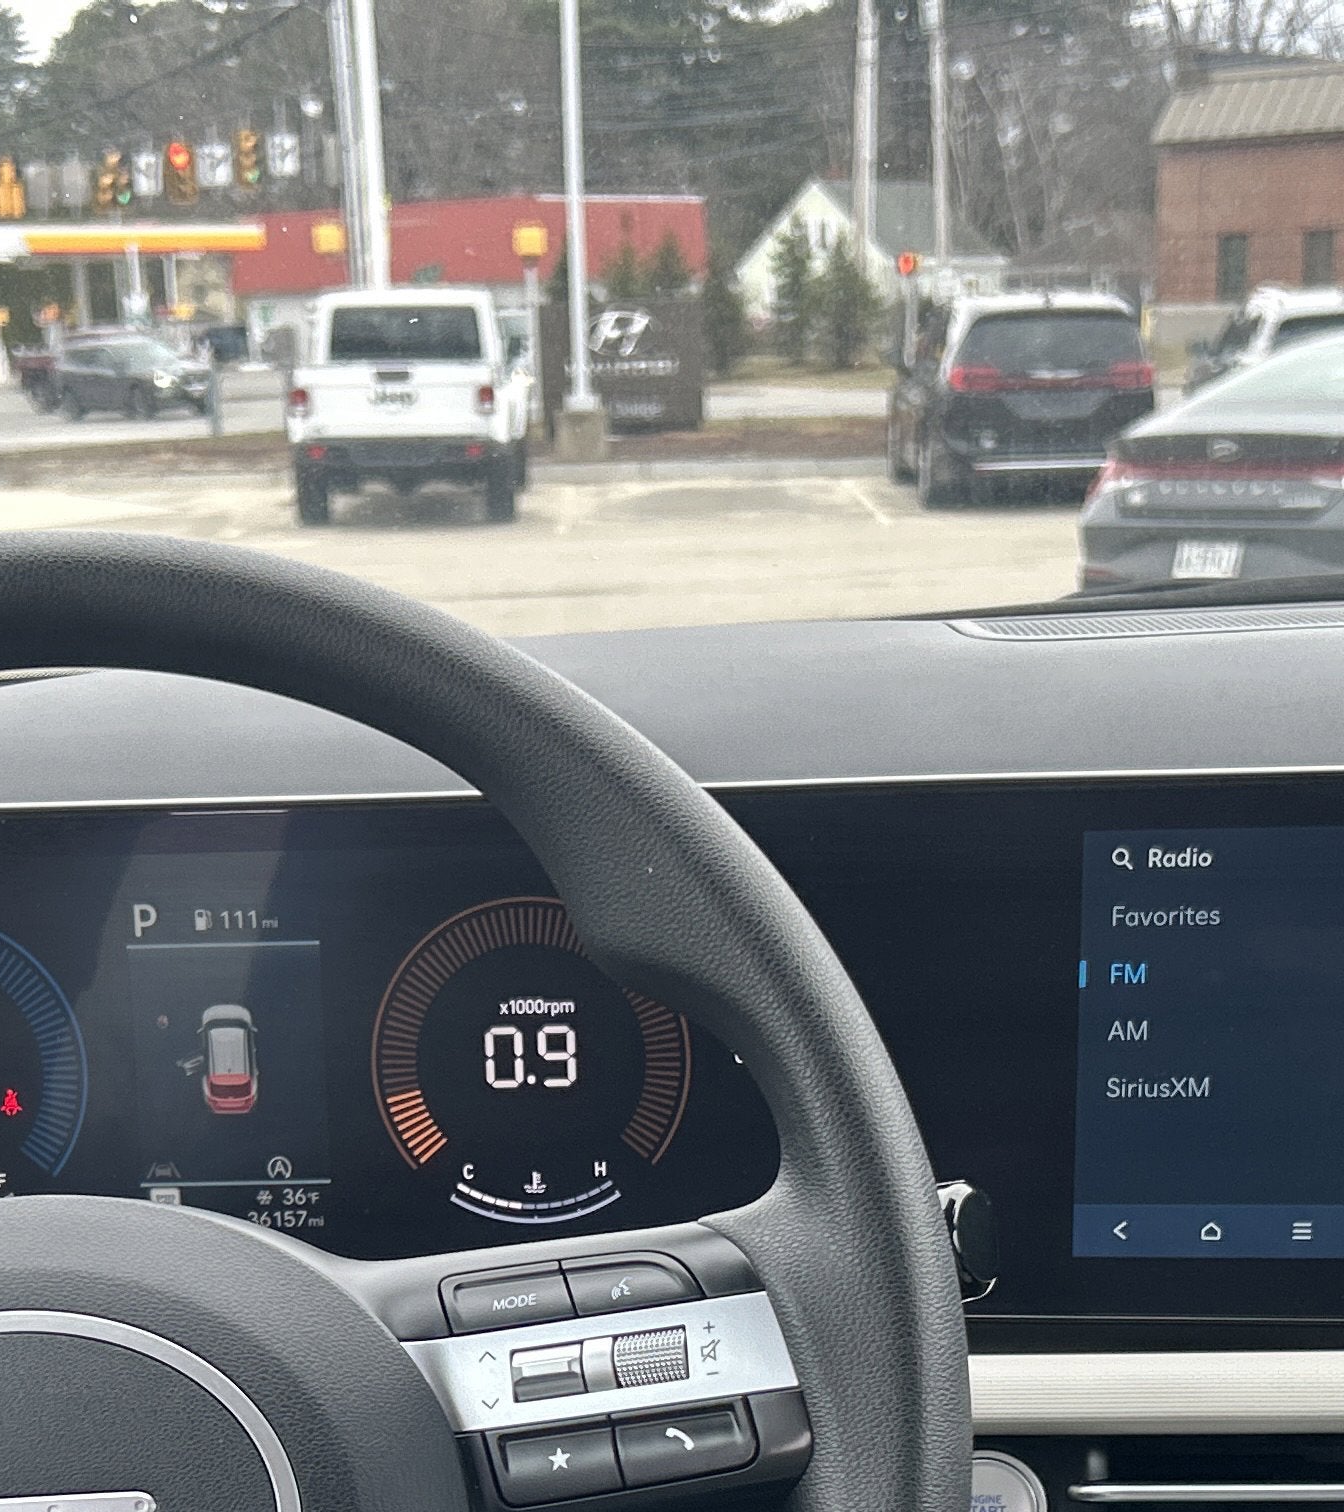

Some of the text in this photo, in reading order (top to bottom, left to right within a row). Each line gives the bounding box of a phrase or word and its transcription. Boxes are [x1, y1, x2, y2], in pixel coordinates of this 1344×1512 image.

[1146, 847, 1214, 870] Radio
[132, 903, 156, 938] P
[1110, 903, 1222, 929] Favorites
[1109, 962, 1147, 986] FM
[498, 999, 575, 1018] x1000rpm
[1107, 1019, 1149, 1043] AM
[483, 1025, 577, 1089] 0.9
[1105, 1076, 1211, 1100] SiriusXM
[462, 1163, 475, 1181] C
[593, 1160, 608, 1178] H
[492, 1292, 538, 1311] MODE
